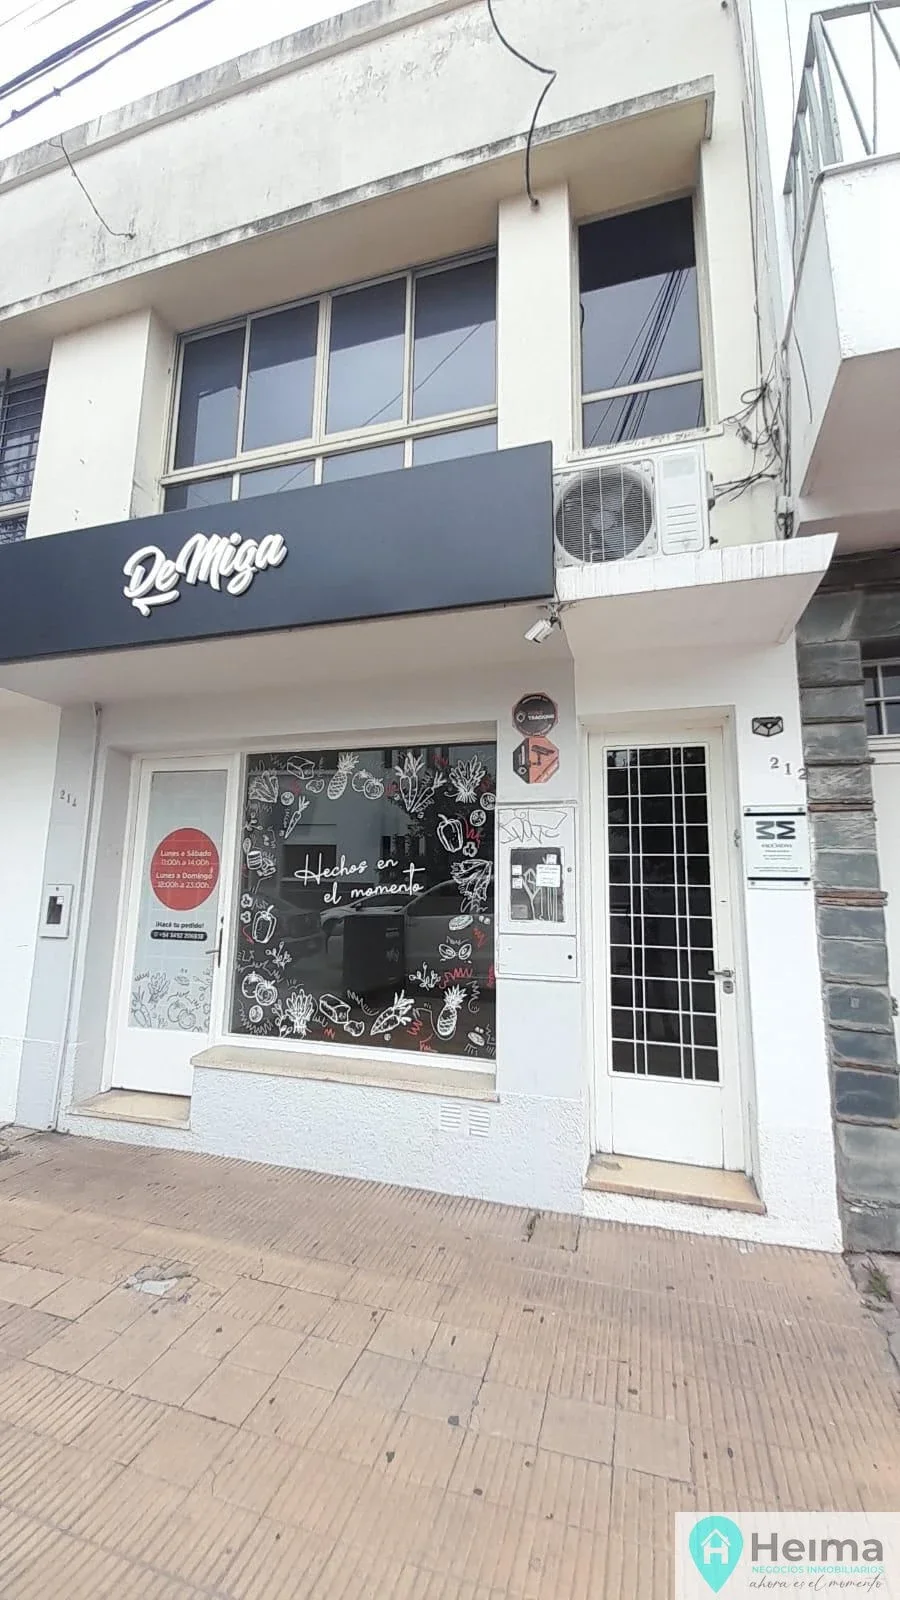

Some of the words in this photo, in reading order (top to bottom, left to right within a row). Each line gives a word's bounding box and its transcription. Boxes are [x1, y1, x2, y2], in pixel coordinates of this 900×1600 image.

[123, 545, 179, 599] De
[175, 532, 288, 596] Miga
[769, 756, 808, 780] 212
[160, 849, 180, 857] Lunes
[186, 849, 212, 857] Sábado
[182, 872, 213, 881] Domingo
[294, 852, 368, 887] Hechos
[377, 859, 398, 870] en
[323, 882, 342, 905] el
[350, 862, 426, 896] momento
